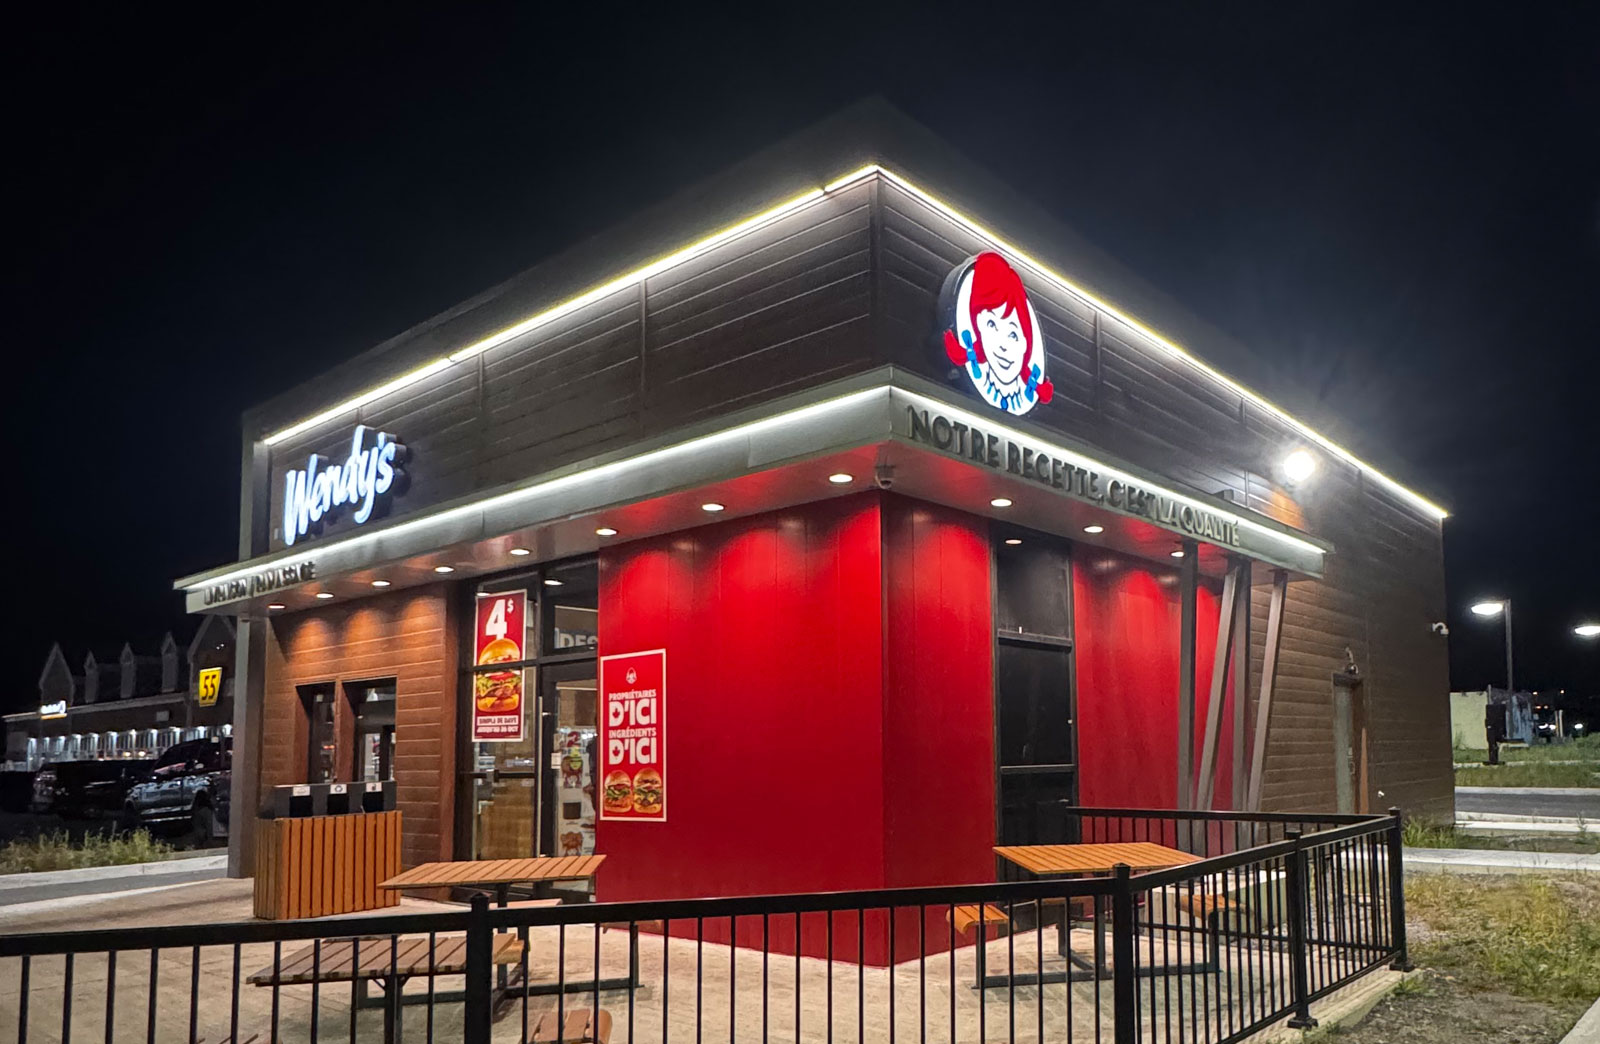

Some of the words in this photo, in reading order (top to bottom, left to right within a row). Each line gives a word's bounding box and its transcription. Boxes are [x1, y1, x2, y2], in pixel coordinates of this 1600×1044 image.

[284, 425, 396, 546] Wendy's
[907, 404, 999, 468] NOTRE
[1157, 497, 1181, 530] LA
[1181, 505, 1240, 547] QUALITÉ
[201, 674, 217, 701] 55
[608, 688, 657, 701] PROPRIÉTAIRES
[608, 698, 657, 727] D'ICI
[608, 726, 657, 738] INGRÉDIENTS
[608, 737, 657, 765] D'ICI
